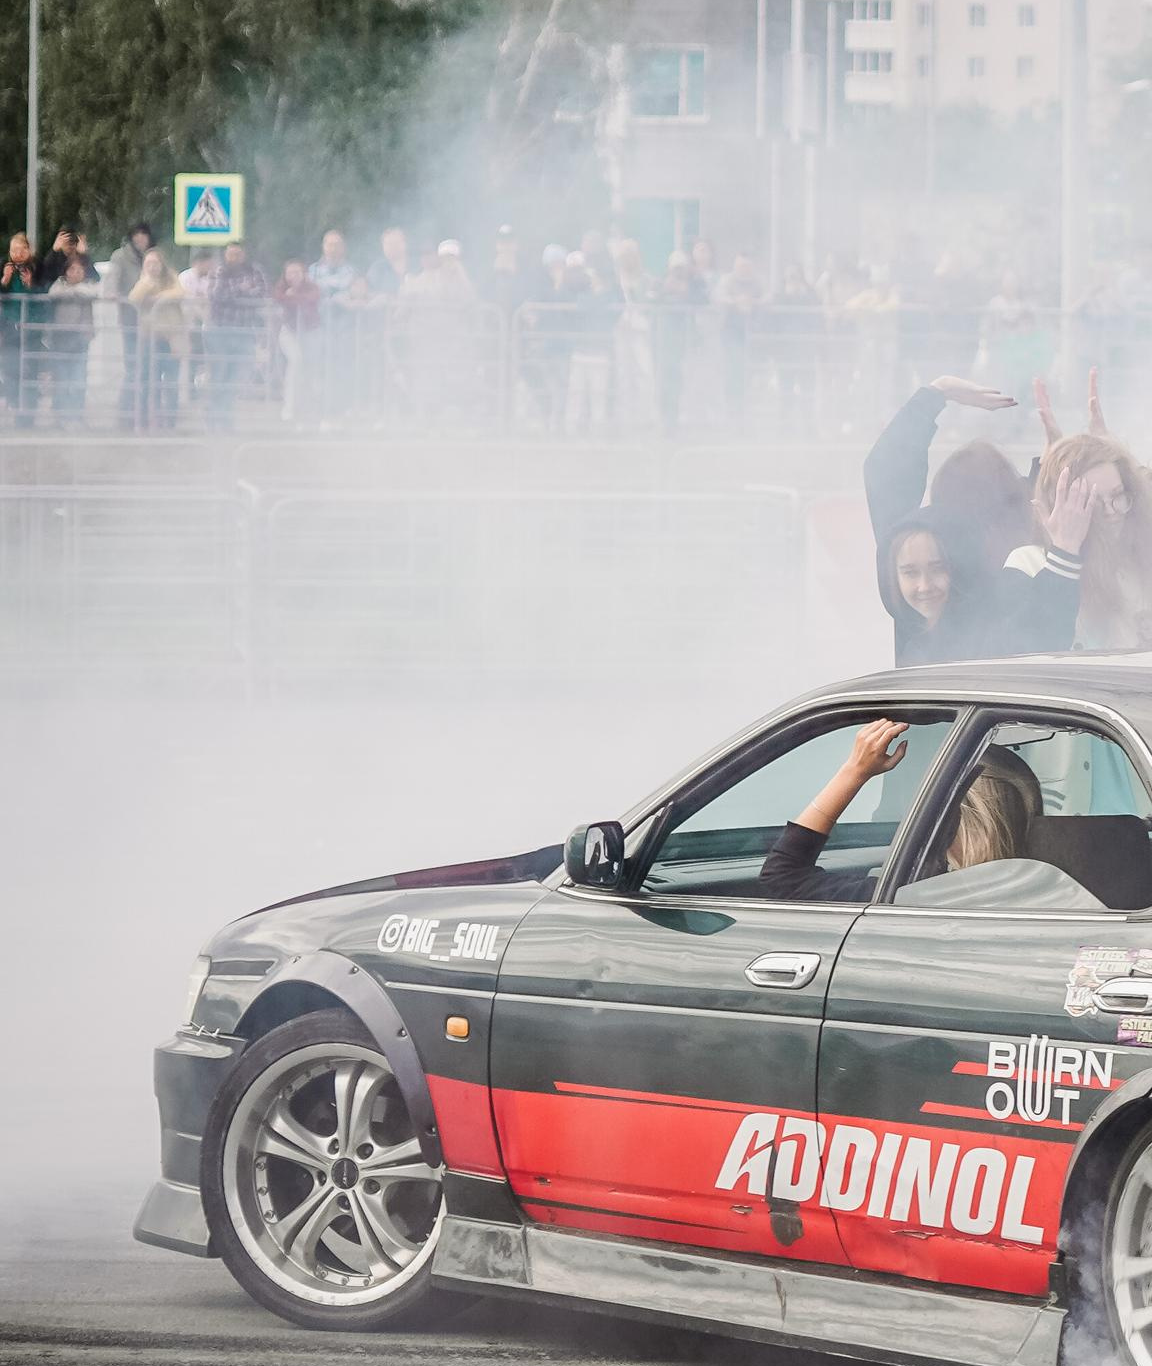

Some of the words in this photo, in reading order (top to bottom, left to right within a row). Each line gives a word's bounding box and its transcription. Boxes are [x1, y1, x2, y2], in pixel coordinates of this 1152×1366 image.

[987, 1035, 1114, 1090] BURN
[985, 1080, 1081, 1125] OUT
[714, 1112, 1046, 1246] ADDINOL
